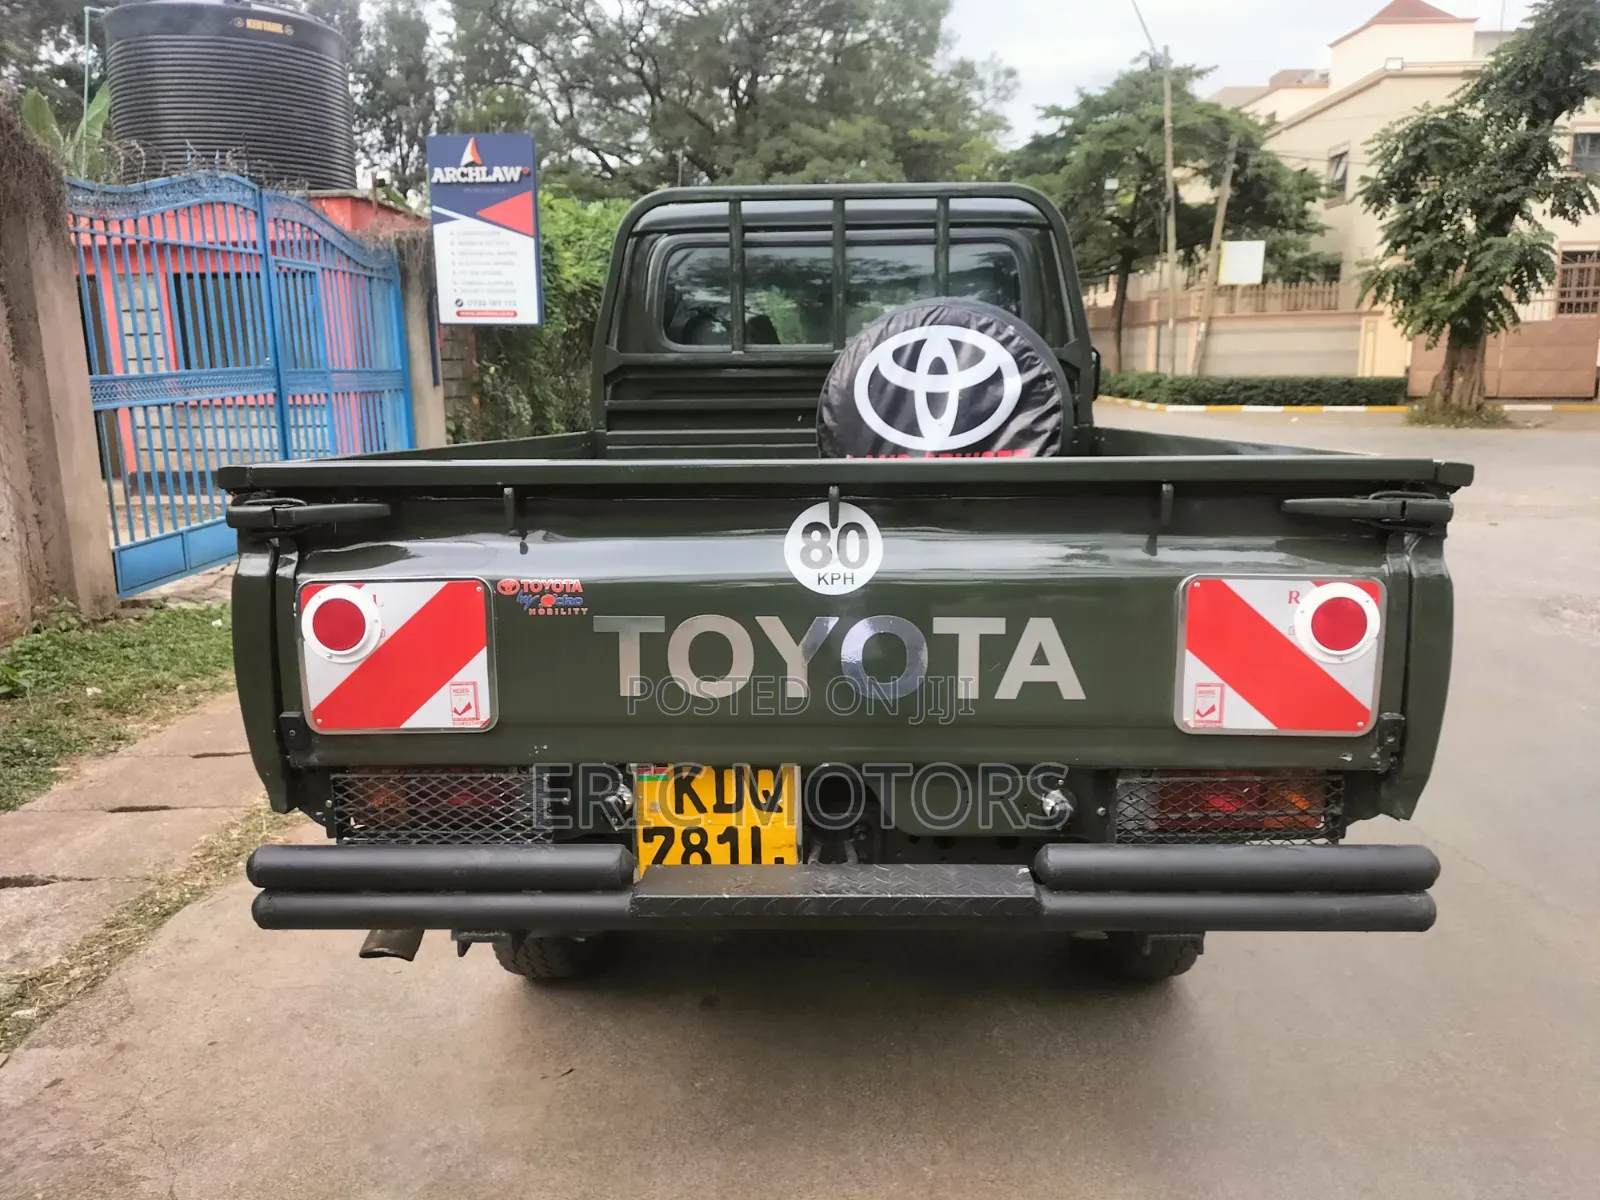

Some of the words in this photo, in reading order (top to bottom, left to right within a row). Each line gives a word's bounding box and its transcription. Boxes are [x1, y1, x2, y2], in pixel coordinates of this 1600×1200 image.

[431, 165, 522, 183] ARCHLAW
[800, 521, 869, 569] 80
[520, 579, 583, 593] TOYOTA
[817, 572, 855, 585] KPH
[1288, 590, 1300, 604] R
[528, 607, 588, 615] MOBILITY
[593, 615, 1087, 700] TOYOTA
[674, 765, 783, 814] KDQ
